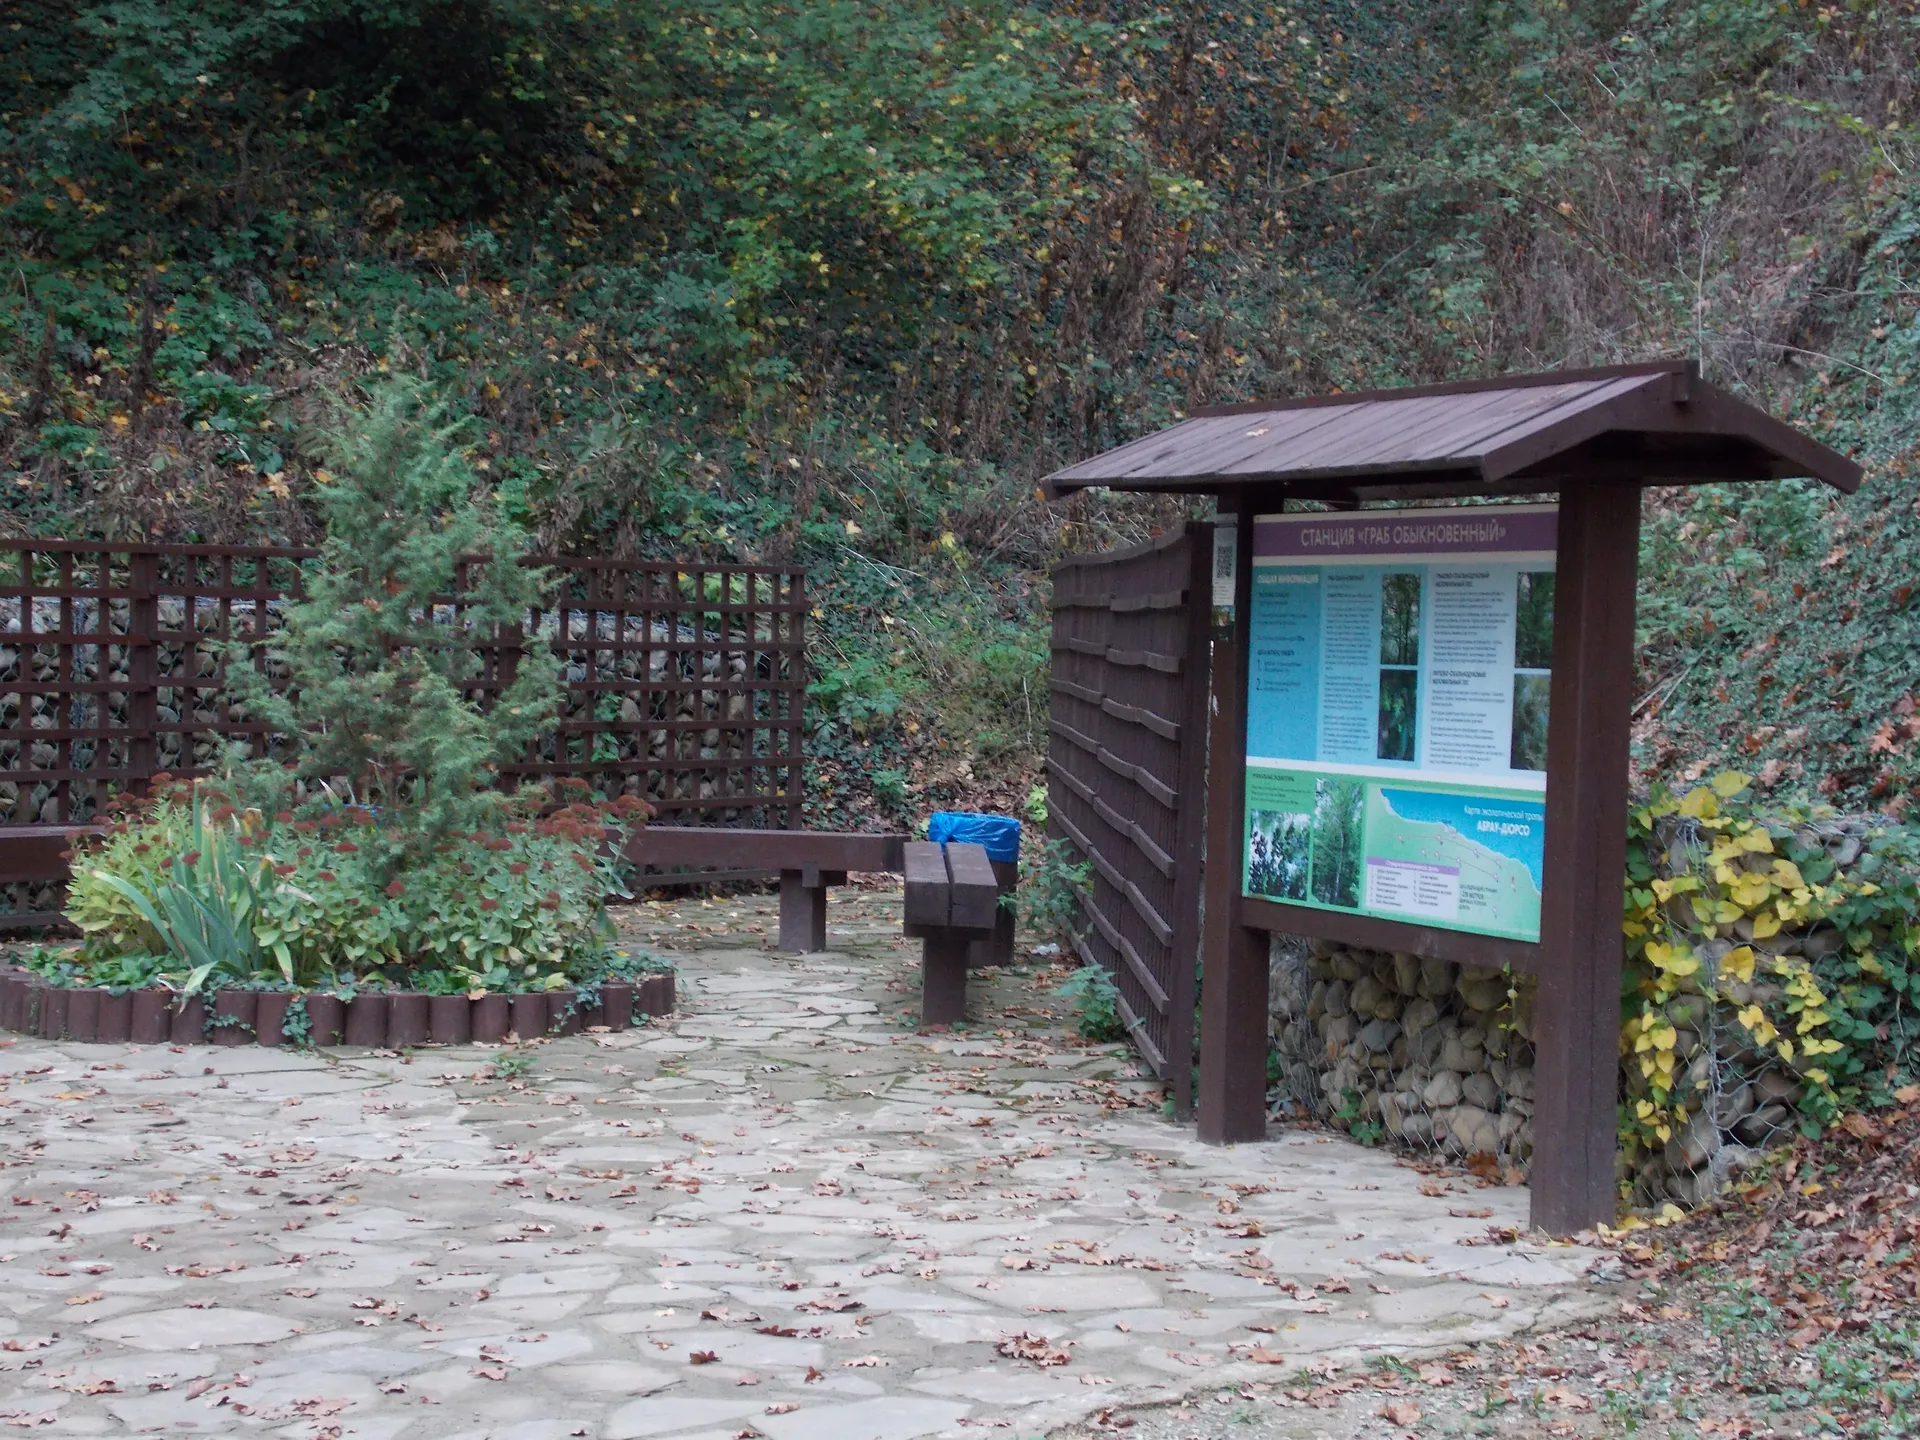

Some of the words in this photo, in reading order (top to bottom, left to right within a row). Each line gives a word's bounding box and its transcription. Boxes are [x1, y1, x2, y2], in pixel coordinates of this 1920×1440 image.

[1301, 527, 1355, 548] СТАНЦИЯ
[1358, 525, 1390, 546] «ГРАБ
[1393, 519, 1507, 545] ОБЫКНОВЕННЫЙ»
[1477, 820, 1530, 836] АБРАУ-ДЮРСО
